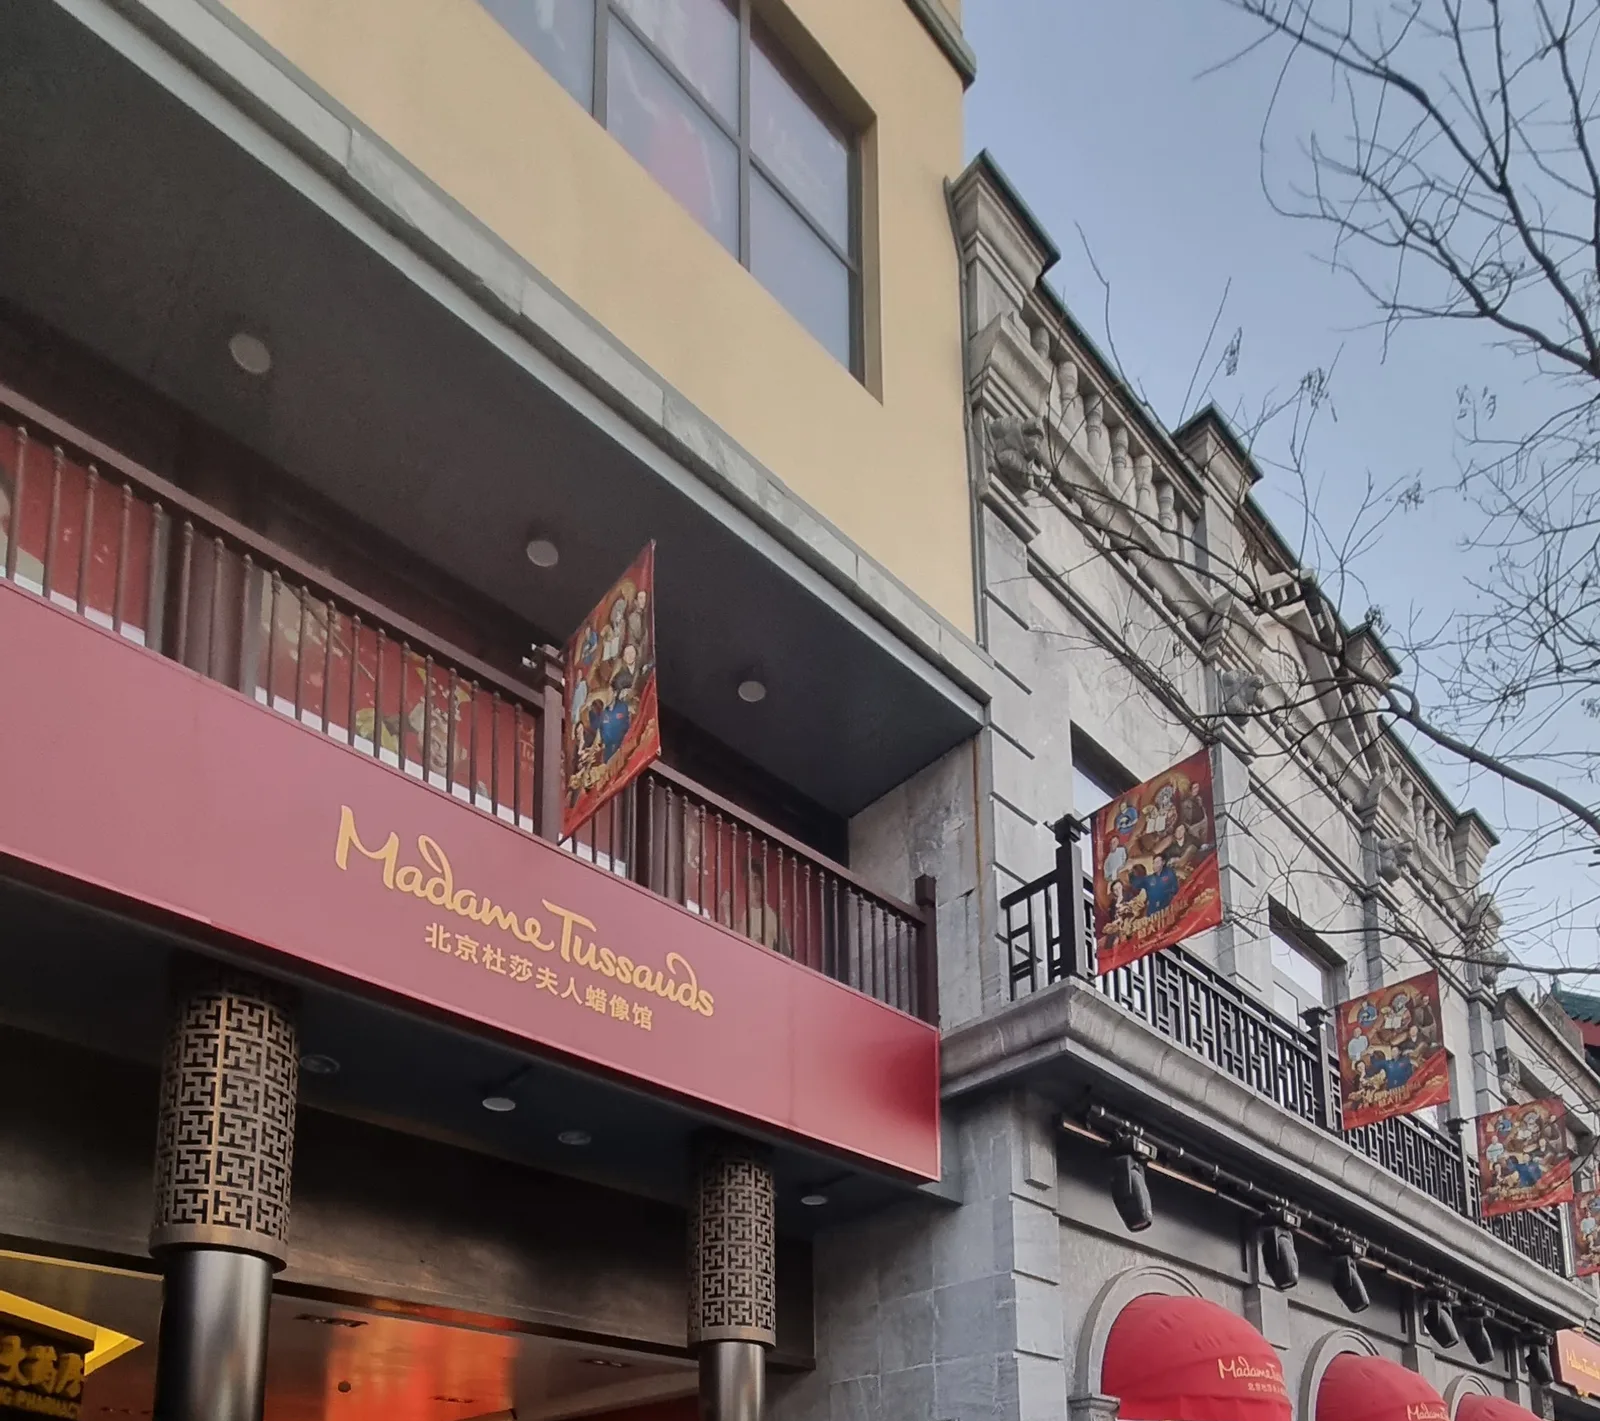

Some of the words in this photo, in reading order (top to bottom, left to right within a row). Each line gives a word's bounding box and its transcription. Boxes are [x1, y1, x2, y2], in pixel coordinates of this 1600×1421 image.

[335, 804, 555, 952] Madame
[542, 898, 715, 1018] Tussauds
[424, 922, 654, 1031] 北京杜莎夫人蜡像馆
